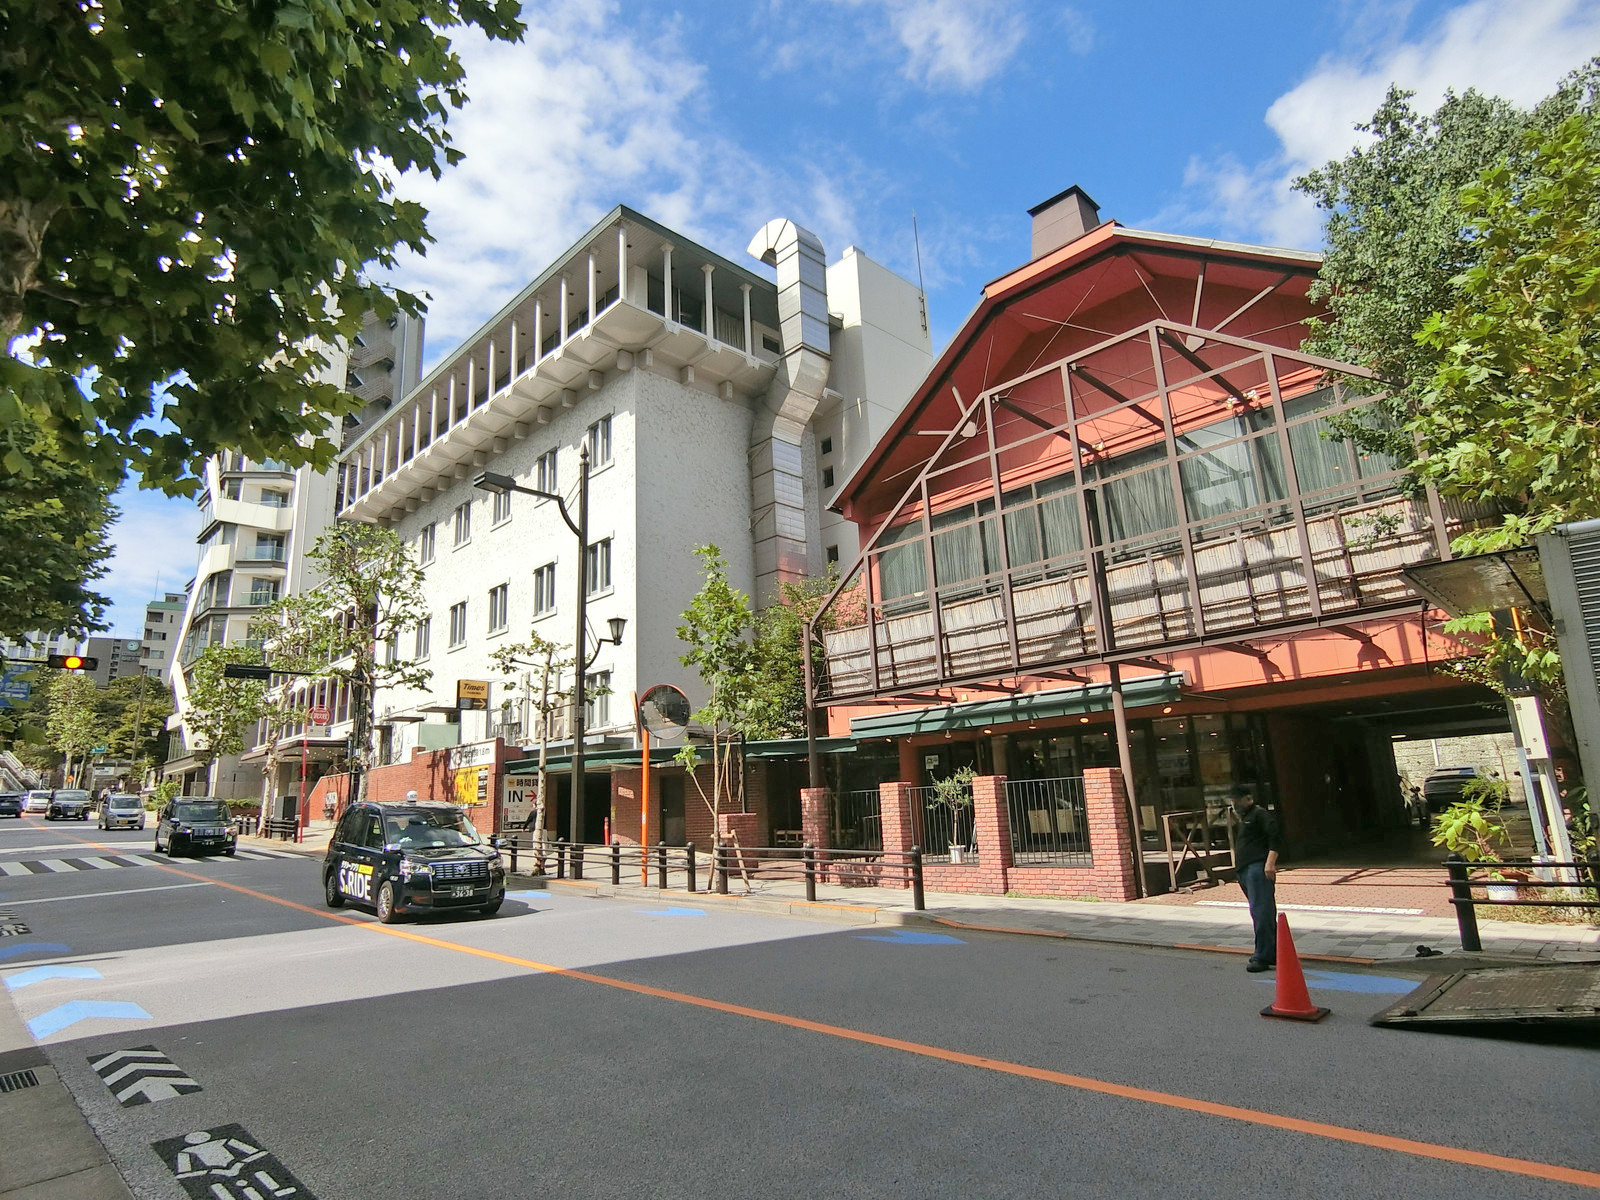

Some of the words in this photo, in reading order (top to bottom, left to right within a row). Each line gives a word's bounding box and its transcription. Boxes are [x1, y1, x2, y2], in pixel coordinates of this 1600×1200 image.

[463, 683, 485, 692] Times
[508, 790, 523, 803] IN
[339, 868, 372, 901] S.RIDE
